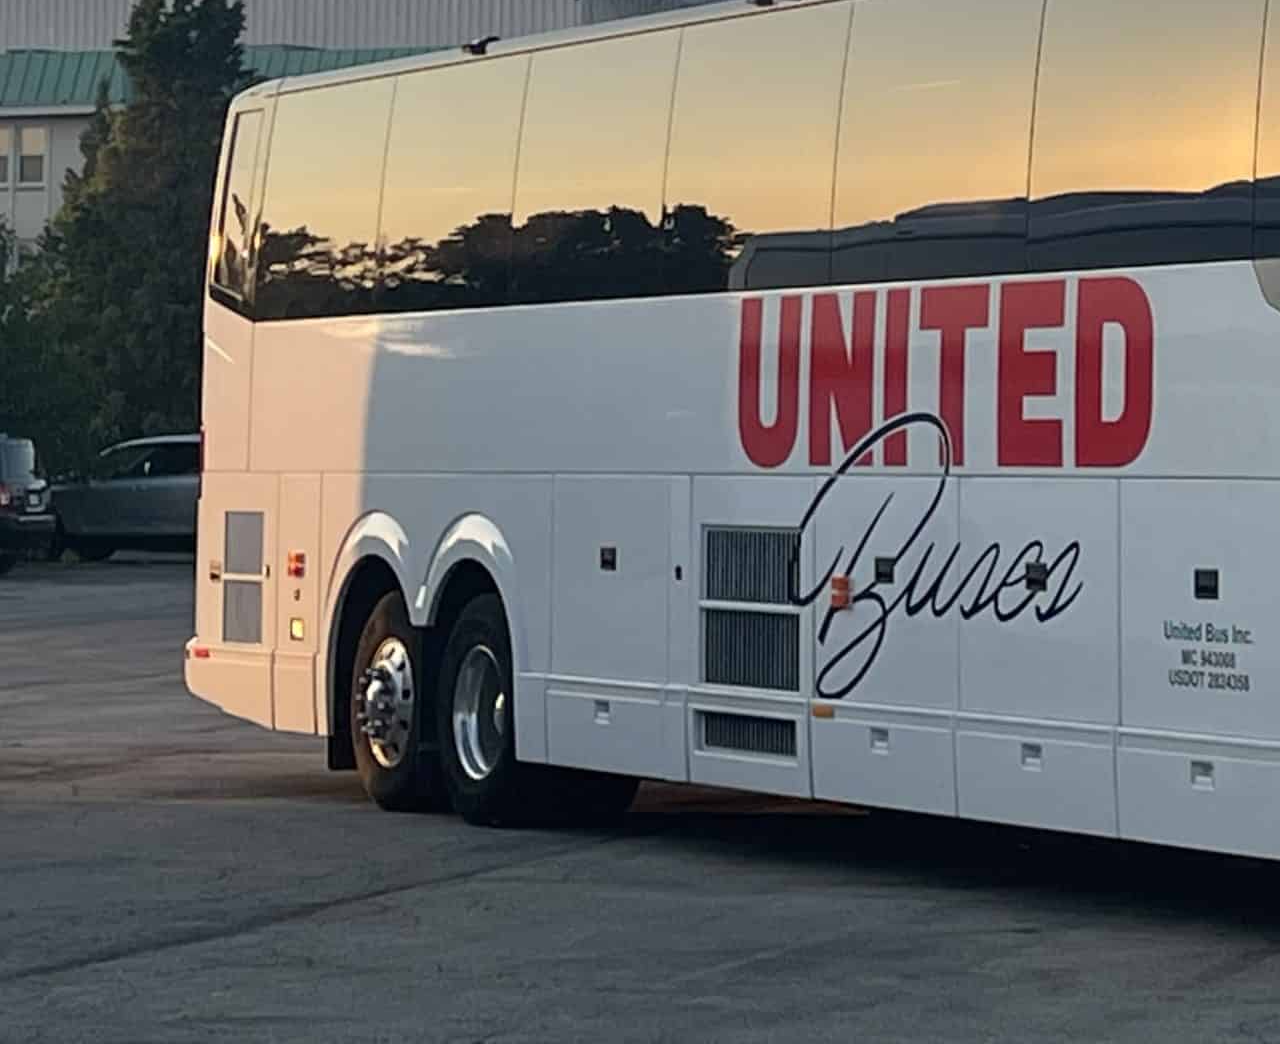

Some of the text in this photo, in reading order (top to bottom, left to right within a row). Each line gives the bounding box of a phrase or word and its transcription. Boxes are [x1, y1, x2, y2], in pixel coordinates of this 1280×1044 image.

[738, 276, 1154, 469] UNITED
[788, 412, 1084, 699] Buses
[1163, 619, 1254, 646] United Bus Inc.
[1181, 649, 1198, 666] MC
[1167, 668, 1205, 688] USDOT
